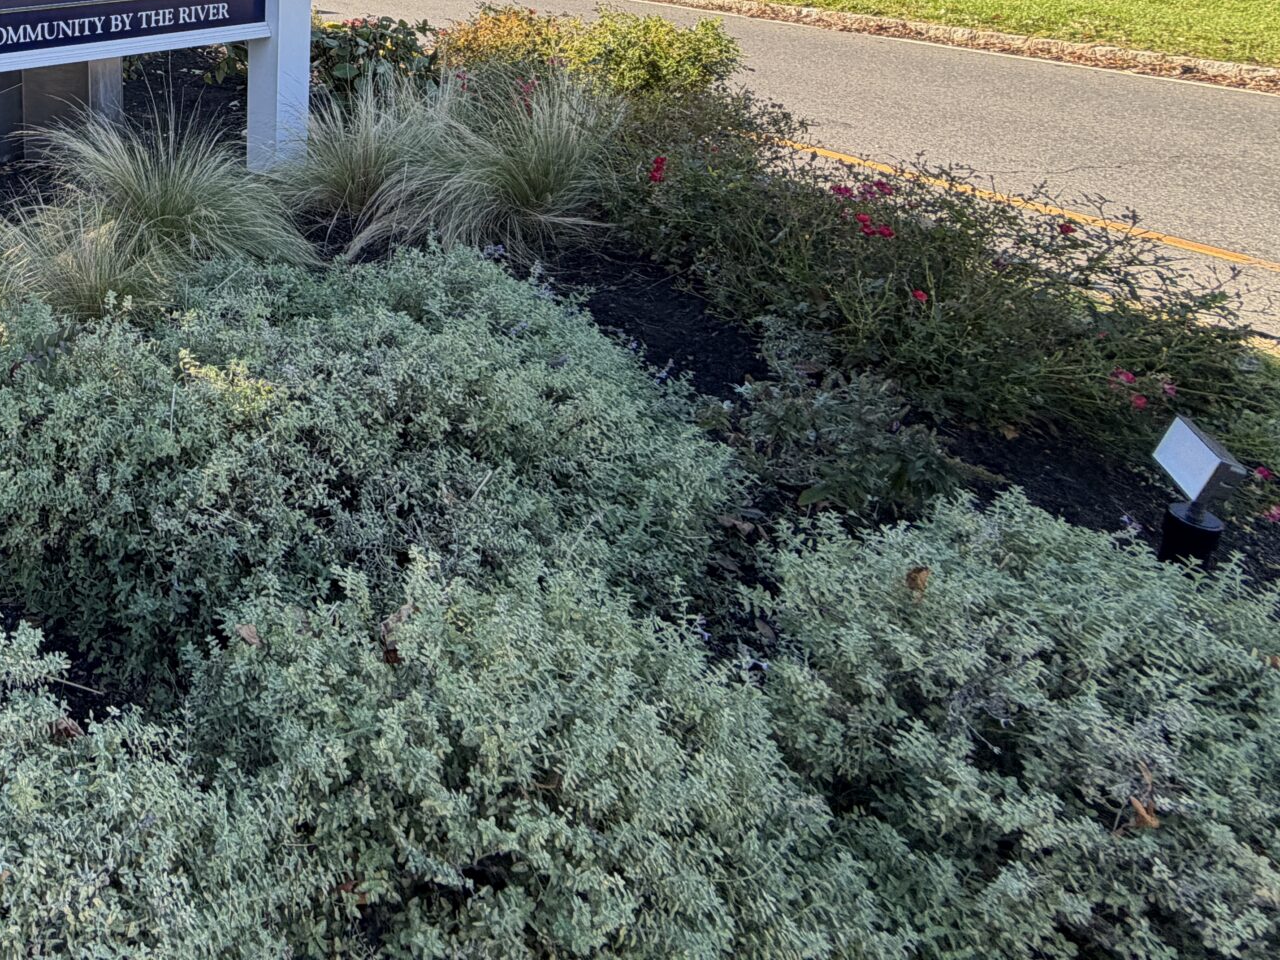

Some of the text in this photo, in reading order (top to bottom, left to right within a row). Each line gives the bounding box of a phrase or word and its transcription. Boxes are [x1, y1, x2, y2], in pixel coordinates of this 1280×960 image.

[109, 13, 134, 33] BY
[137, 8, 175, 29] THE
[178, 2, 230, 24] RIVER
